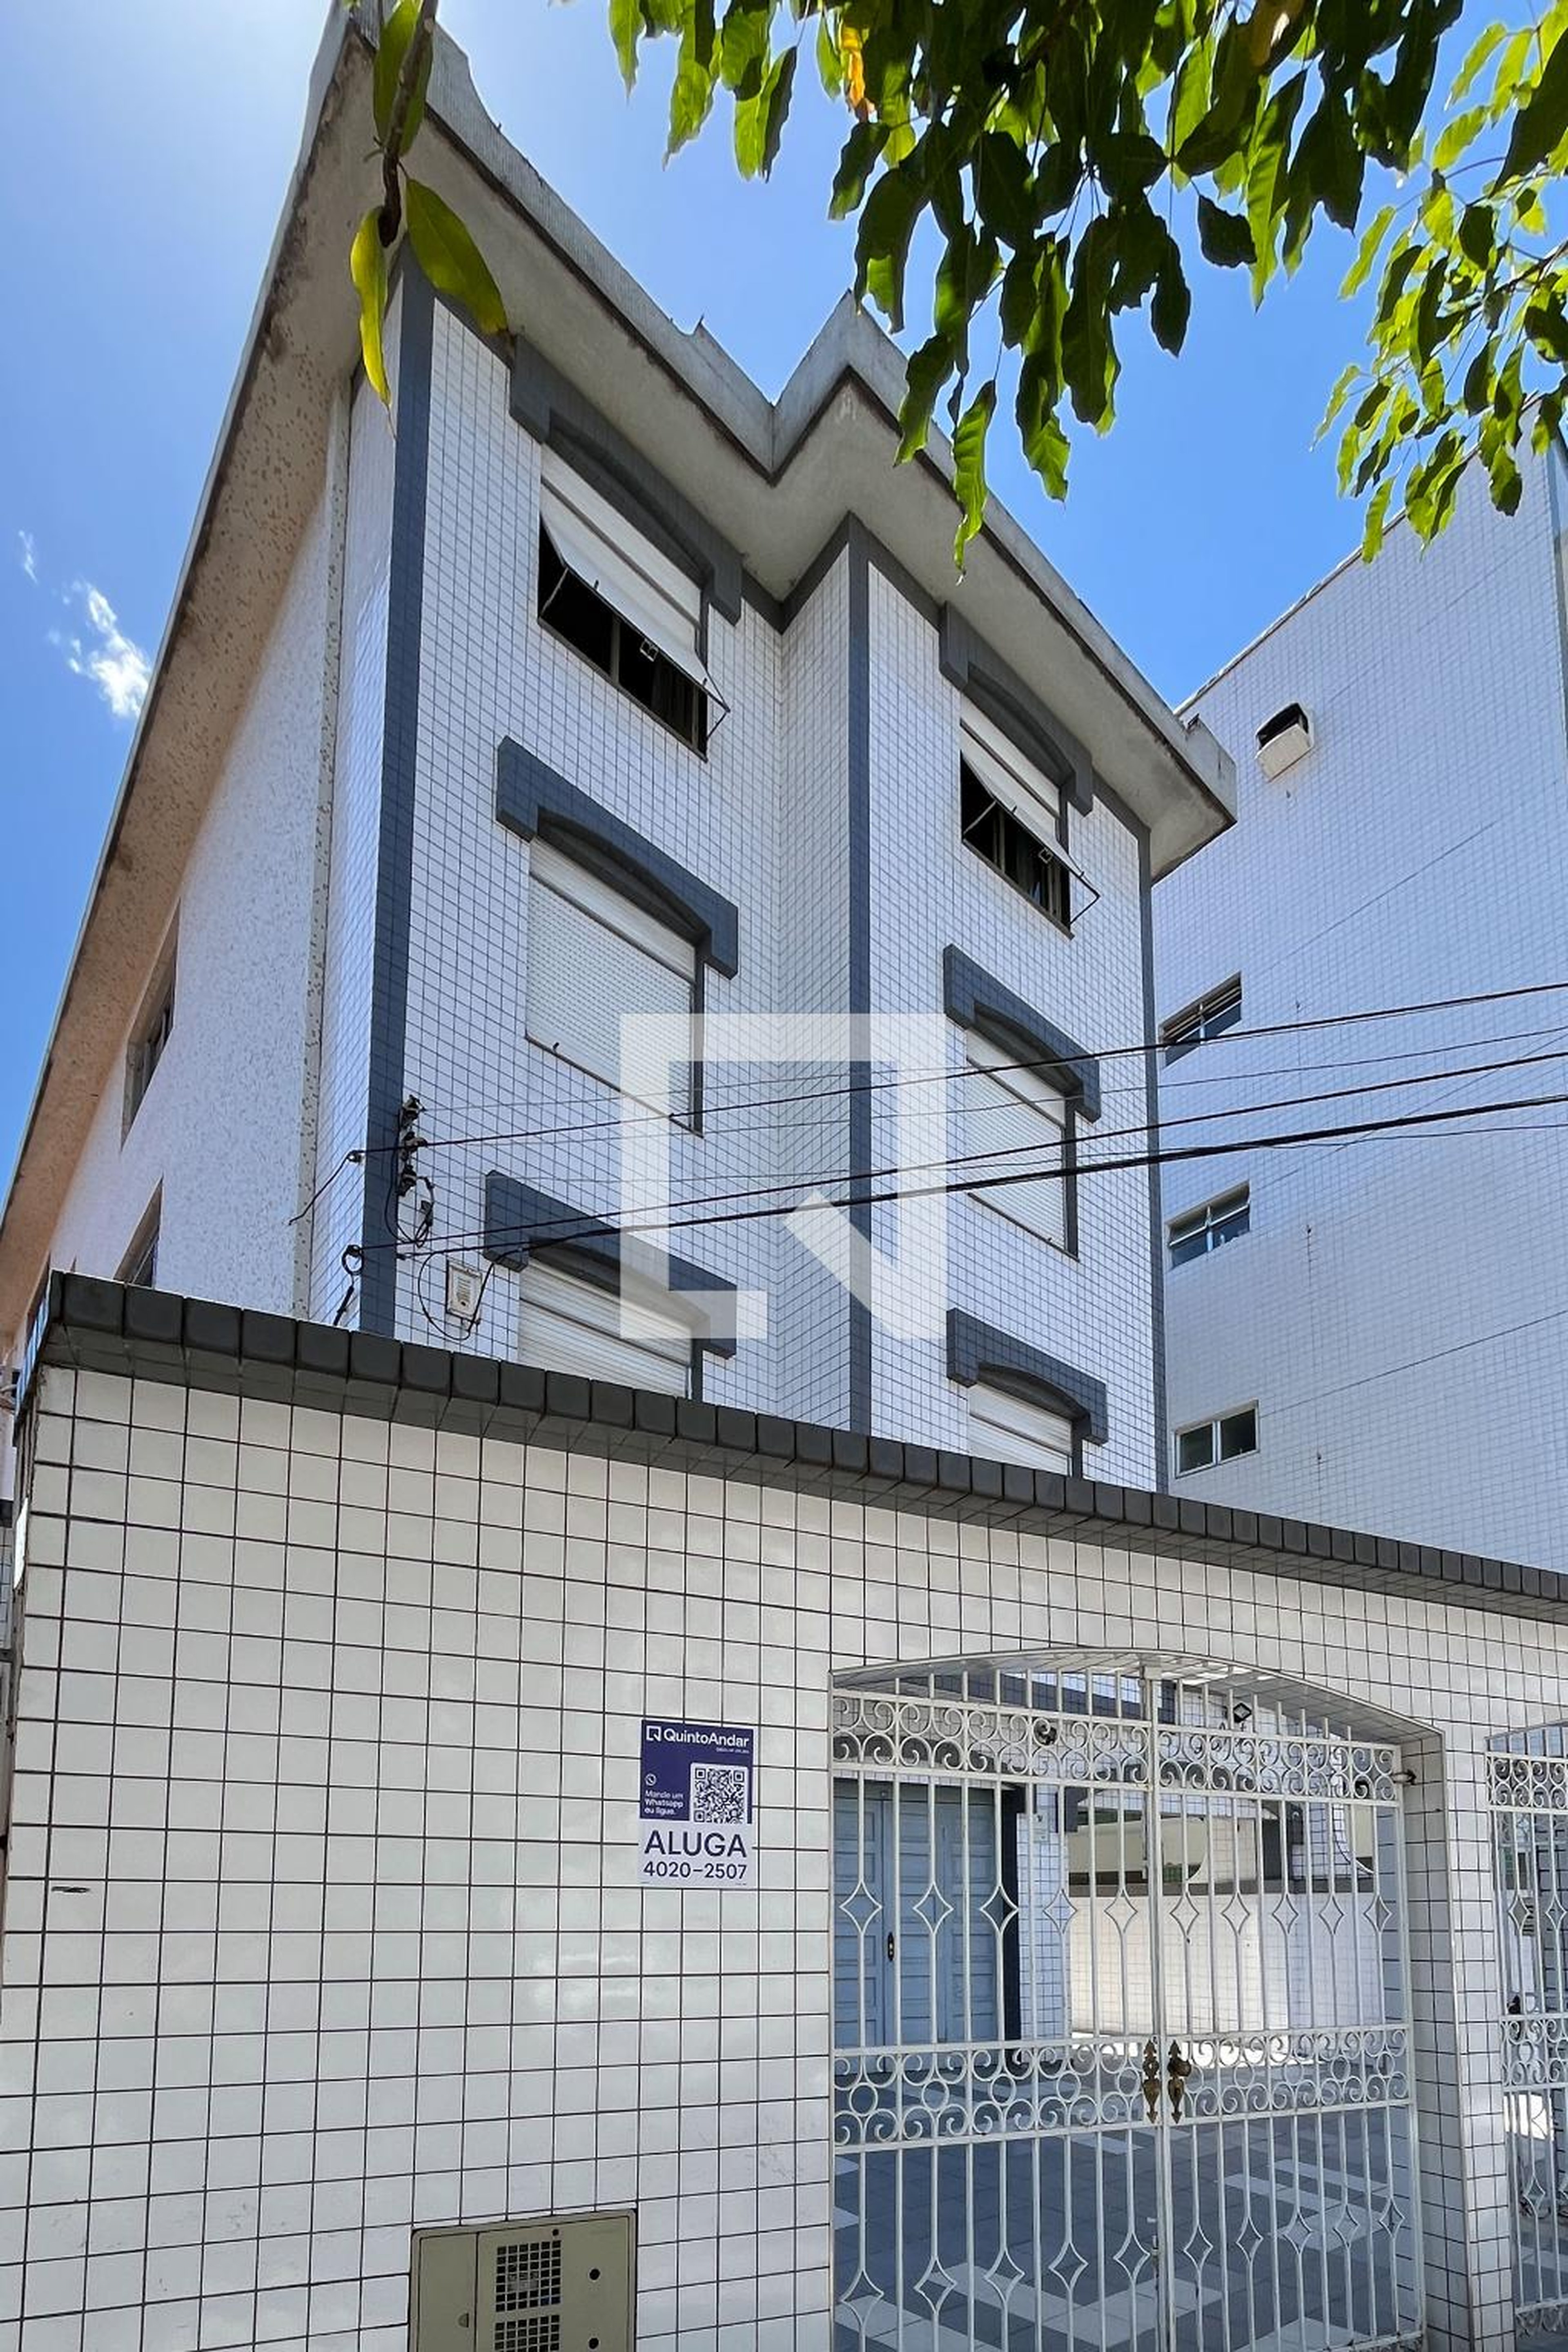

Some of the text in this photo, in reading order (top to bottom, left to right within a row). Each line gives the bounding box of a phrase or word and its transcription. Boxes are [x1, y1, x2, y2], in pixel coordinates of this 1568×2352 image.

[664, 1728, 749, 1747] QuintoAndar
[644, 1830, 747, 1858] ALUGA
[644, 1861, 747, 1879] 4020-2507
